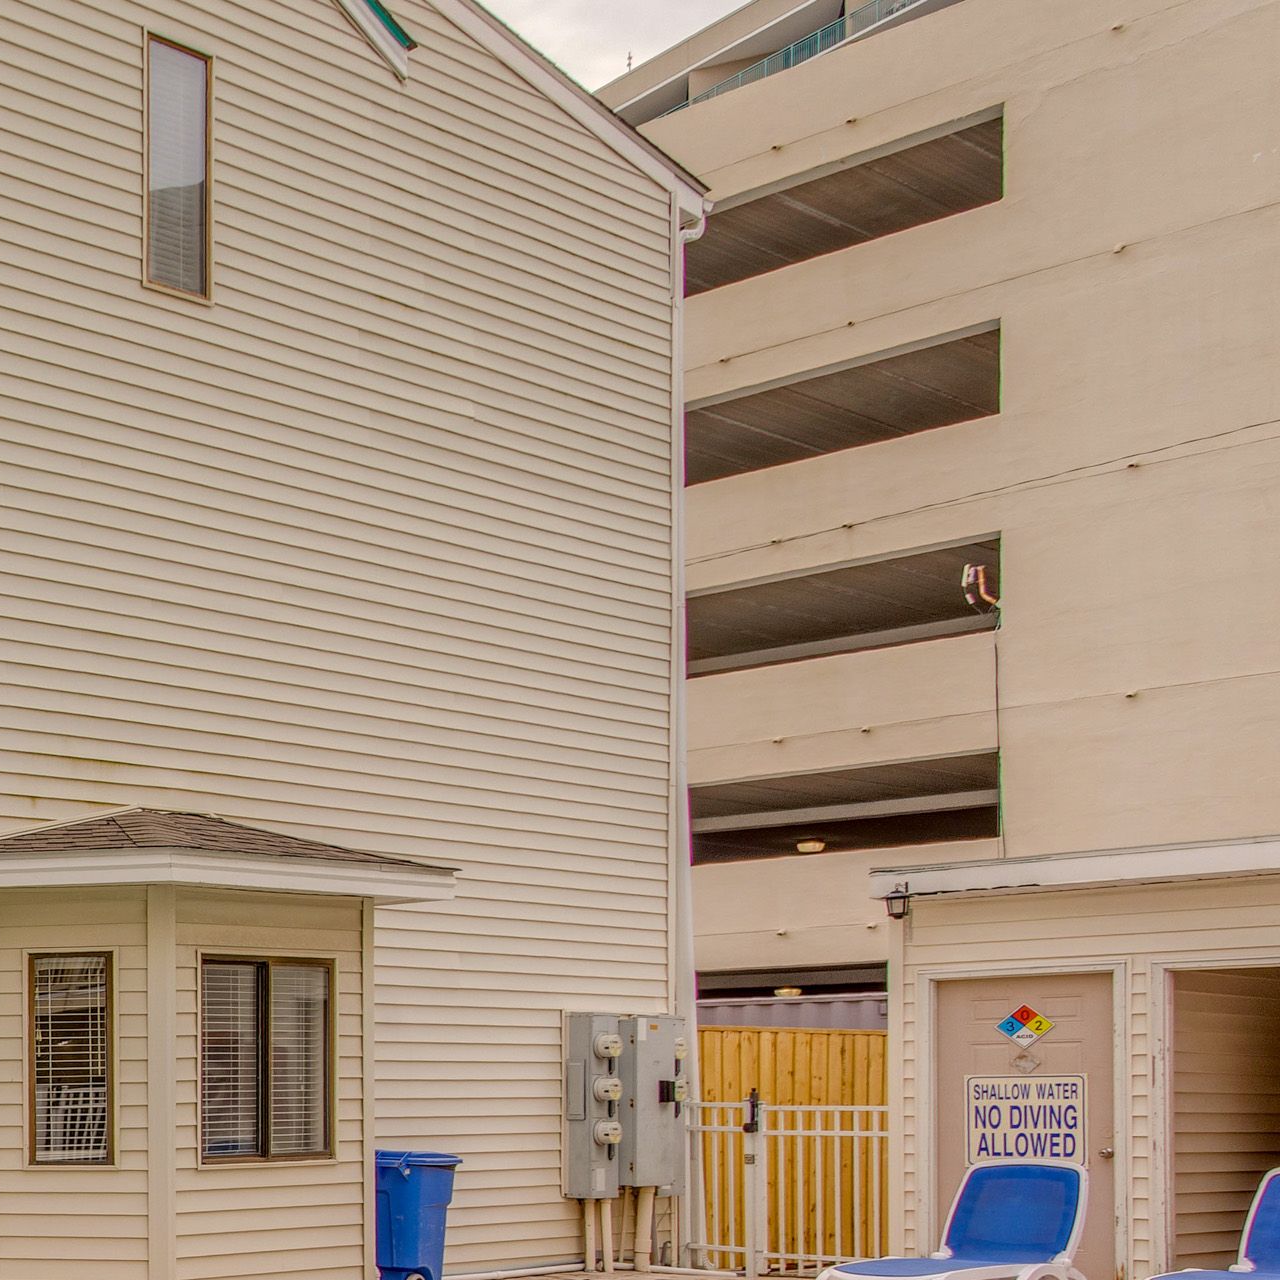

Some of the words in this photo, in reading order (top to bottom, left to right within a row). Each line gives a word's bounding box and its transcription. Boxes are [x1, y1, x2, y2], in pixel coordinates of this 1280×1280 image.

[1021, 1010, 1030, 1020] 0
[1006, 1021, 1015, 1032] 3
[1035, 1020, 1043, 1031] 2
[973, 1084, 1030, 1100] SHALLOW
[1036, 1083, 1078, 1100] WATER
[974, 1105, 1001, 1129] NO
[1009, 1105, 1078, 1129] DIVING
[977, 1133, 1076, 1157] ALLOWED
